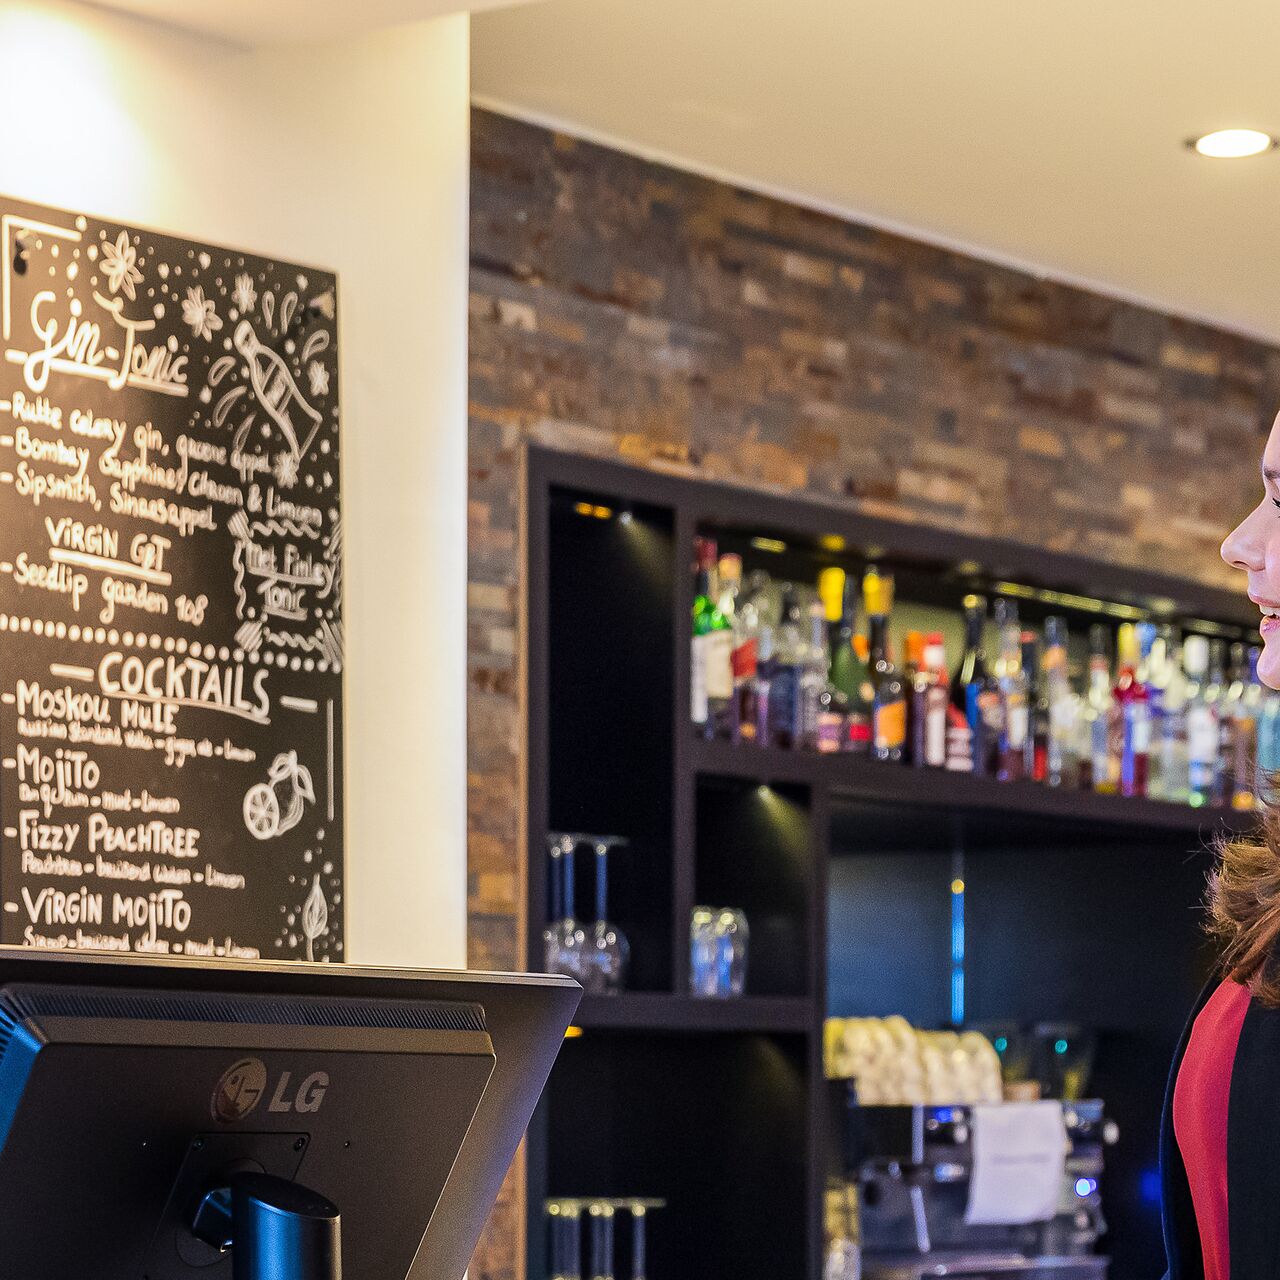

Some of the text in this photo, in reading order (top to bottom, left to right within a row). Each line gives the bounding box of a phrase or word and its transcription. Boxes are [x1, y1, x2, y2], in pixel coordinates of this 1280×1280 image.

[16, 426, 90, 482] Bombay
[14, 552, 89, 612] Seedlip
[175, 594, 209, 626] 108
[98, 651, 270, 718] COCKTAILS
[268, 1071, 329, 1113] LG
